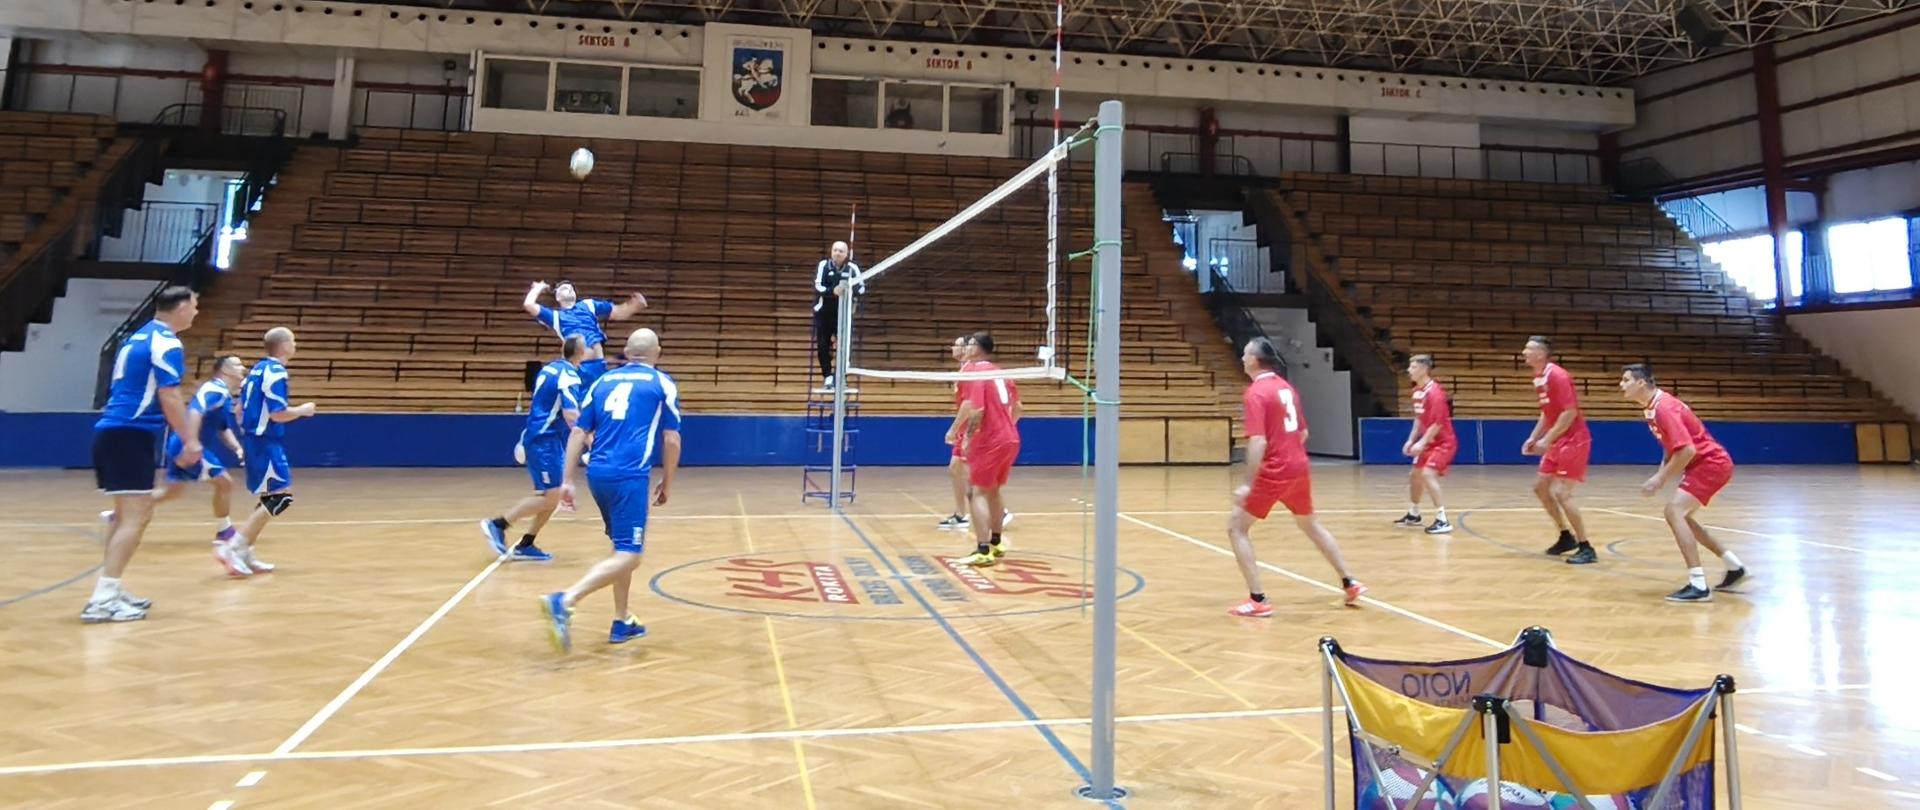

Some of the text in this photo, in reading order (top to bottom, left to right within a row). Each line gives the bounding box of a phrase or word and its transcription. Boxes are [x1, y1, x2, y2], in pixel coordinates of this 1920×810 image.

[604, 382, 633, 420] 4
[1278, 388, 1298, 433] 3
[813, 566, 851, 602] ROKITA
